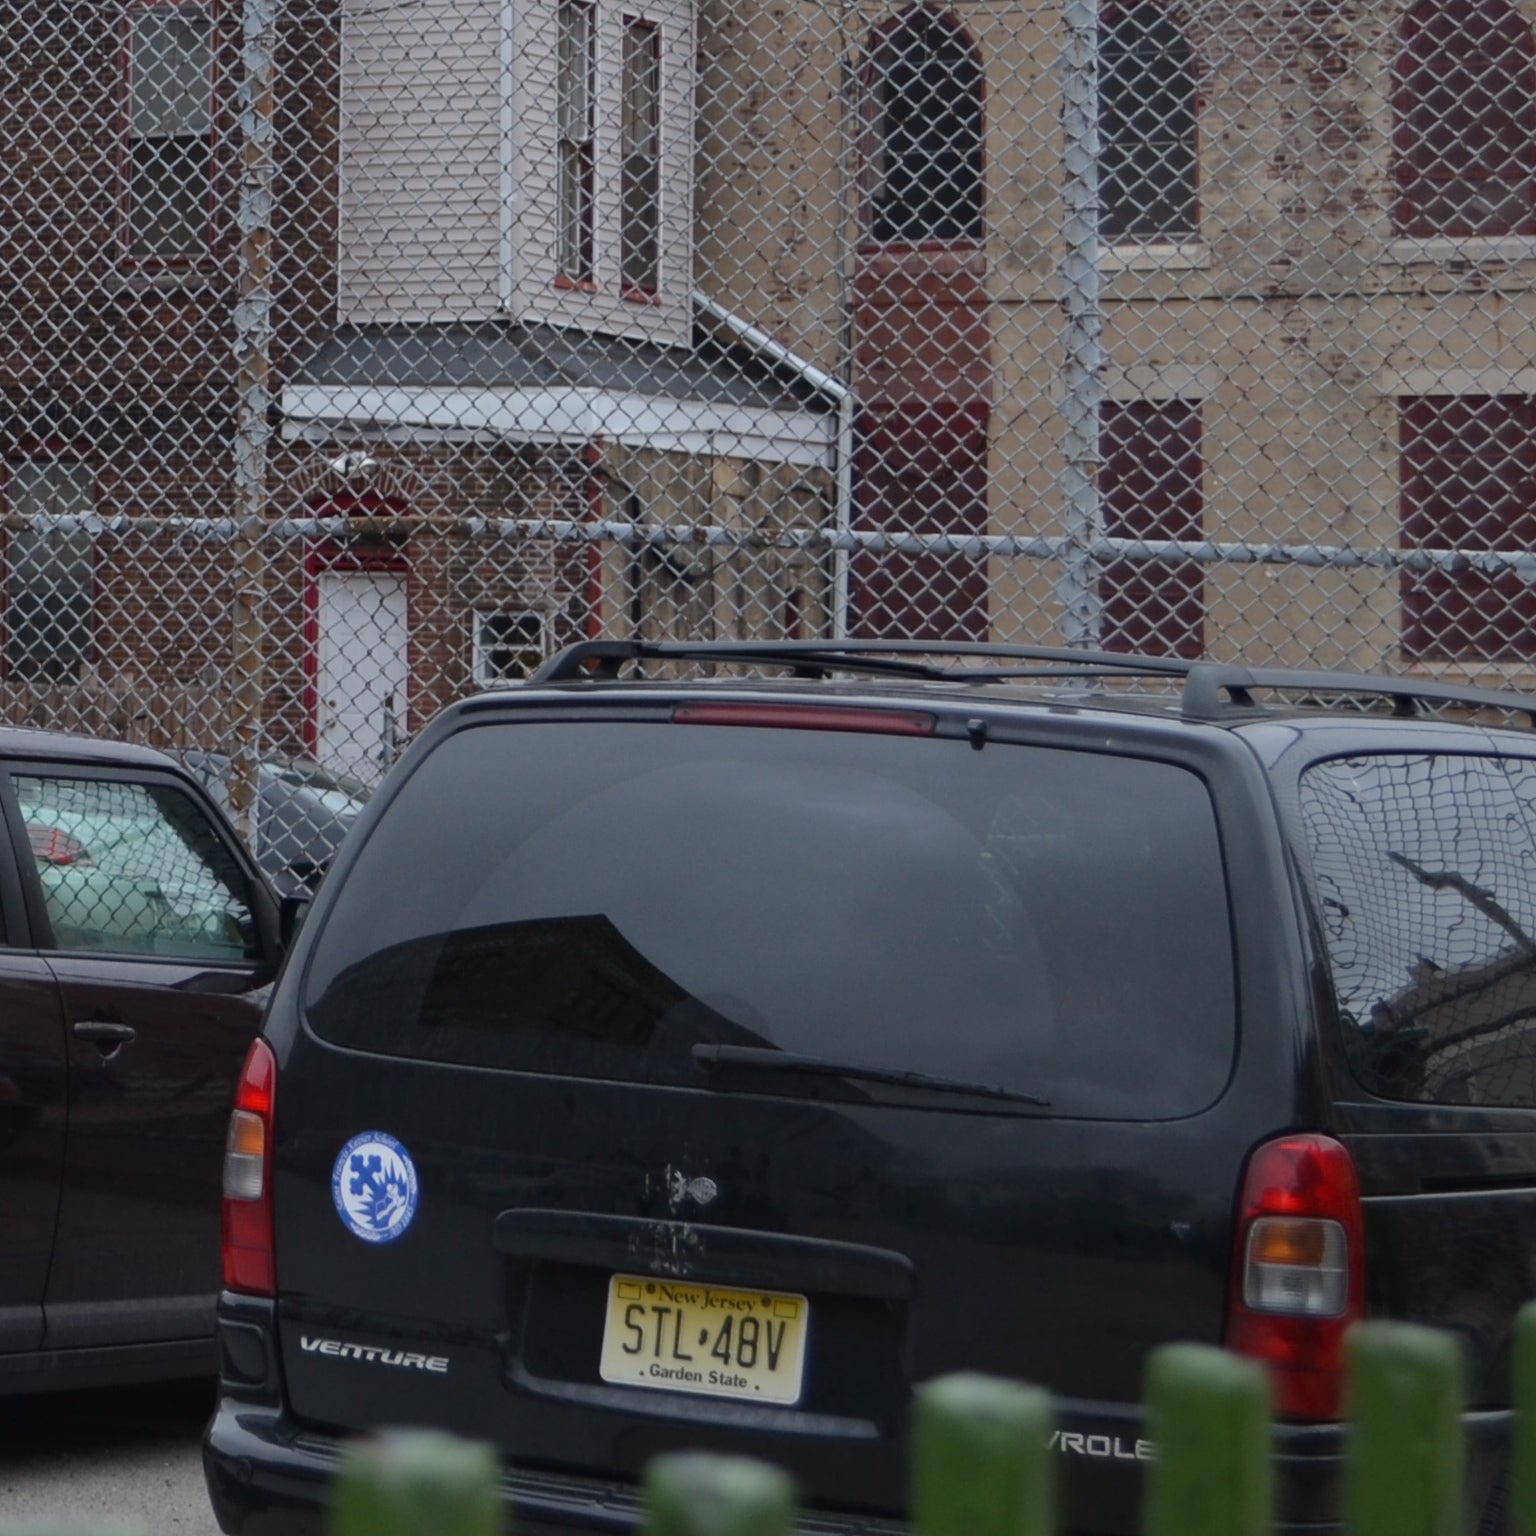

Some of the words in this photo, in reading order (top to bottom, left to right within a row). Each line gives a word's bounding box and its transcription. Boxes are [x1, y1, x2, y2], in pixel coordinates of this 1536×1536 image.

[657, 1285, 699, 1303] New
[700, 1290, 757, 1313] Jersey
[649, 1363, 702, 1383] Garden
[707, 1370, 748, 1389] State
